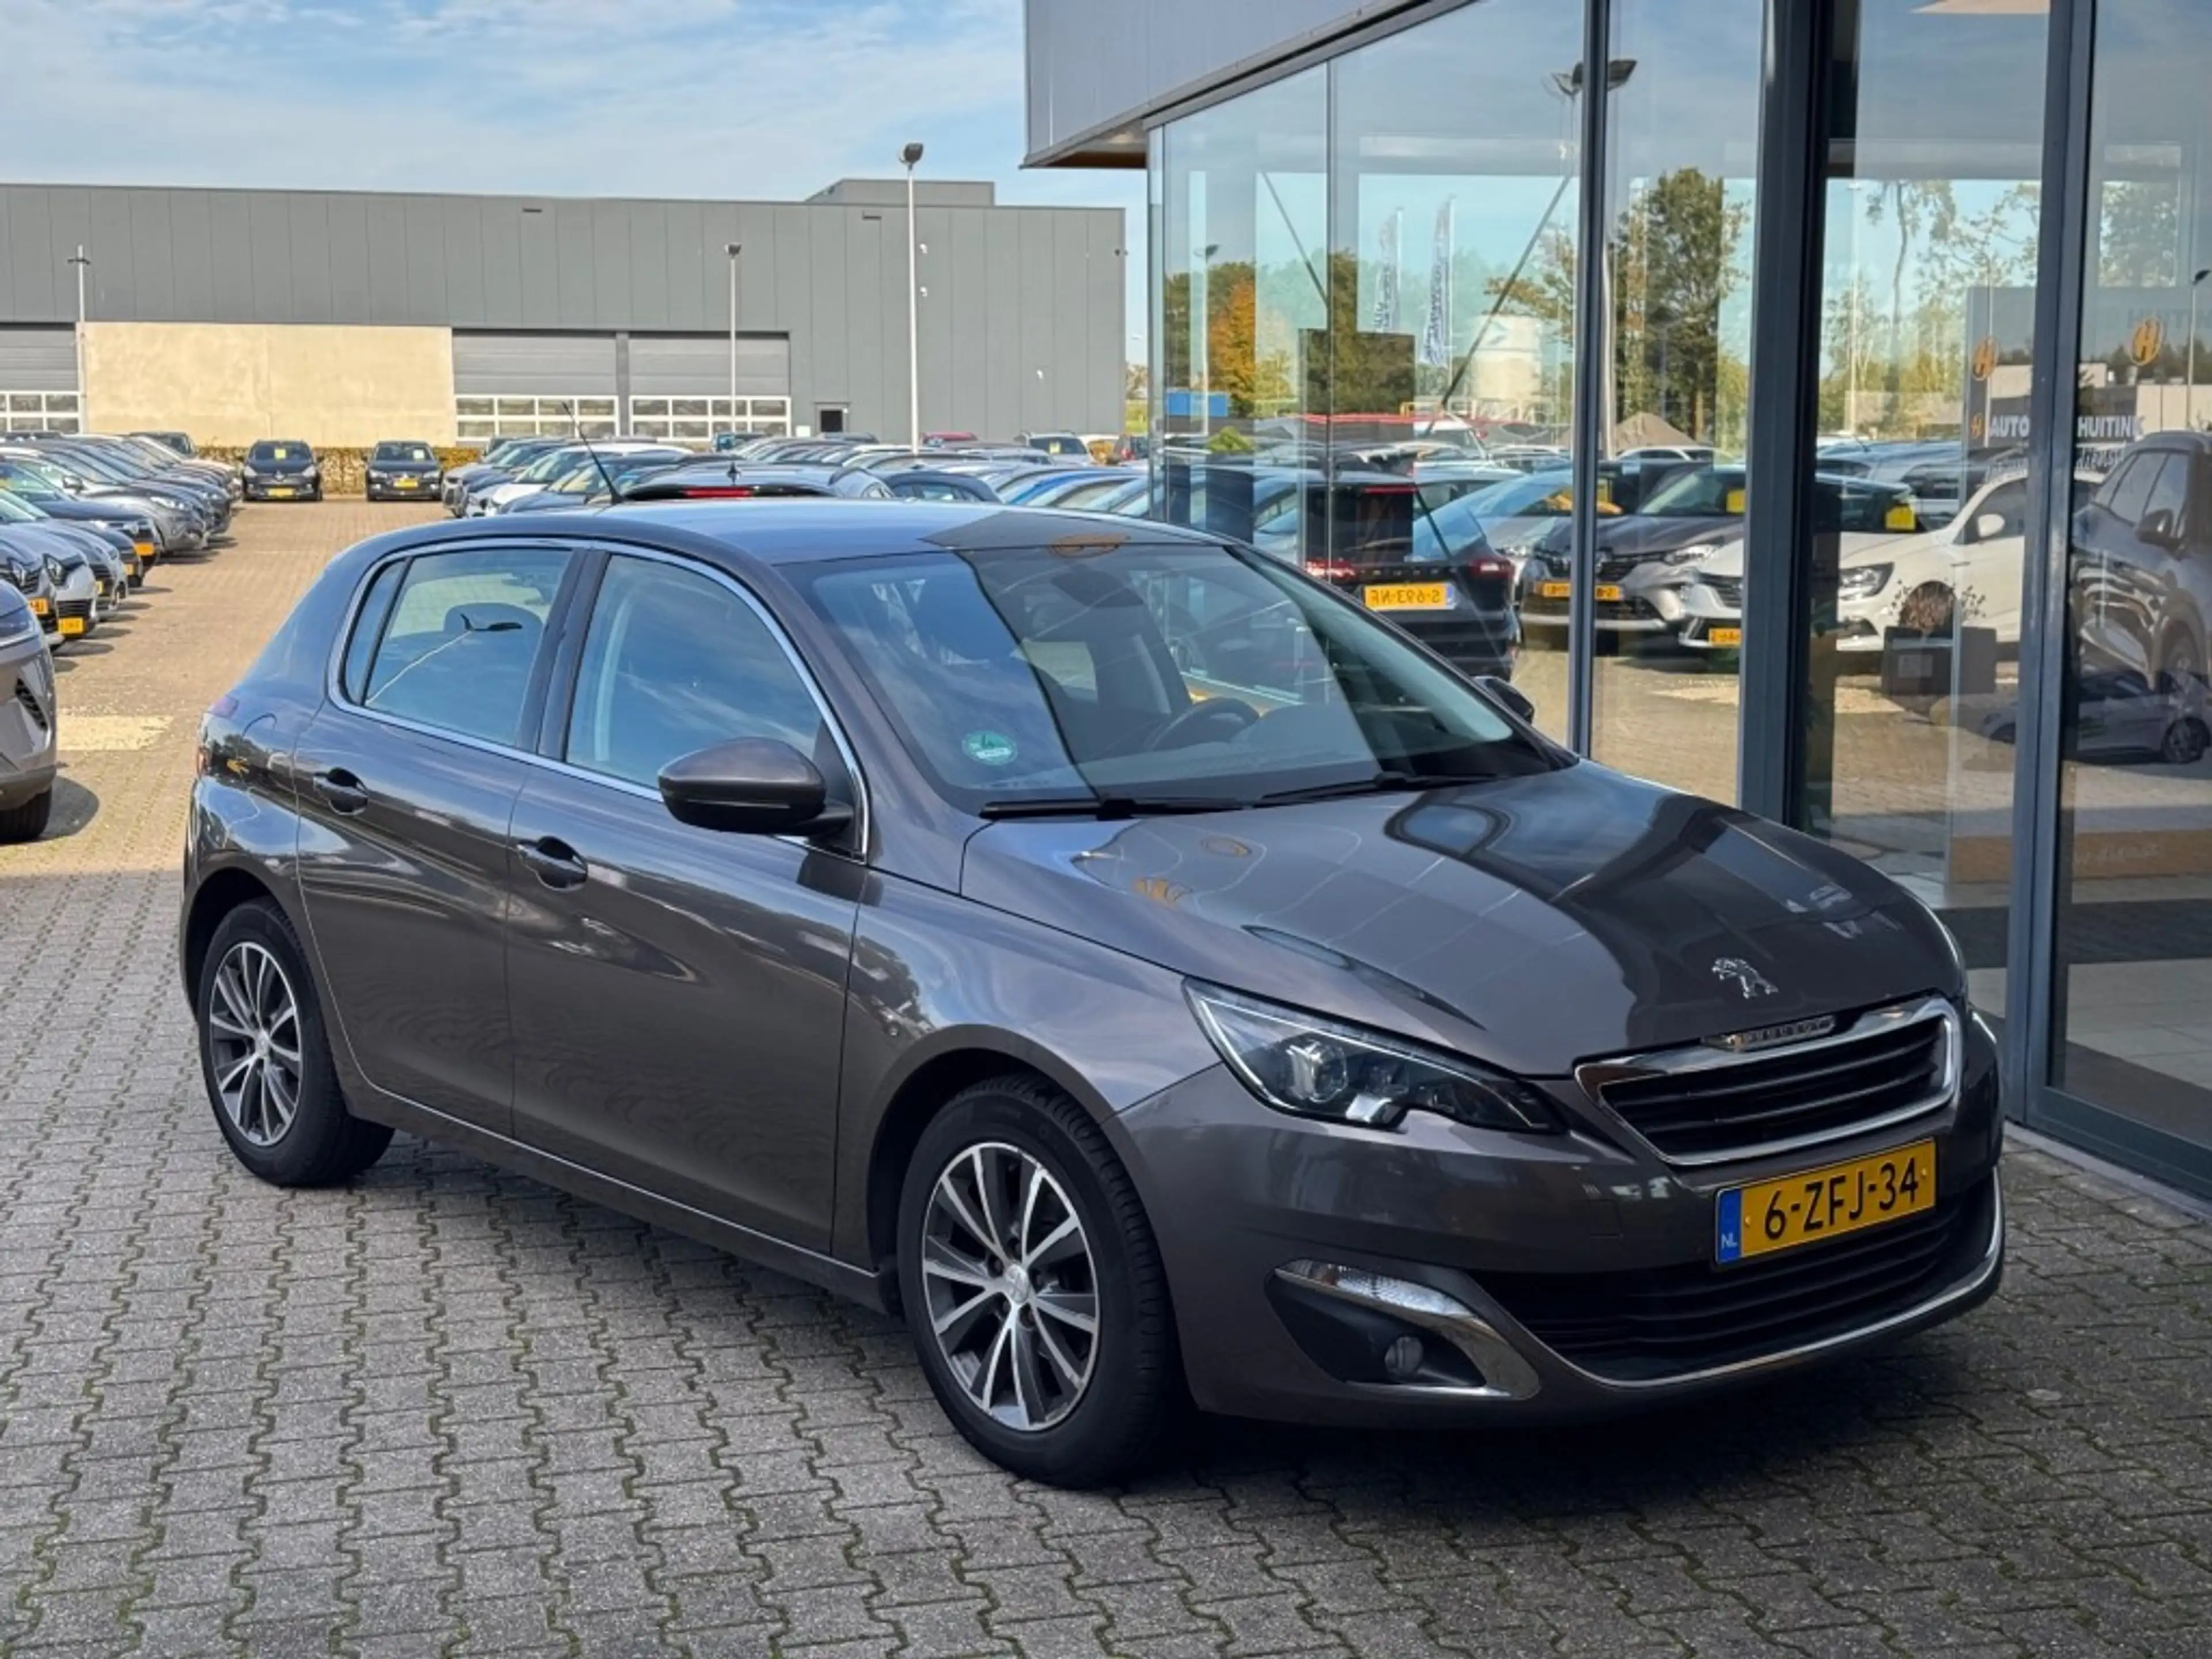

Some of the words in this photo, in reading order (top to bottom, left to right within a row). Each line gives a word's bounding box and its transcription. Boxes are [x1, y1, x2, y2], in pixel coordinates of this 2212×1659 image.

[1988, 415, 2030, 438] AUTO
[1764, 1157, 1919, 1240] 6-ZFJ-34
[1721, 1233, 1738, 1250] NL
